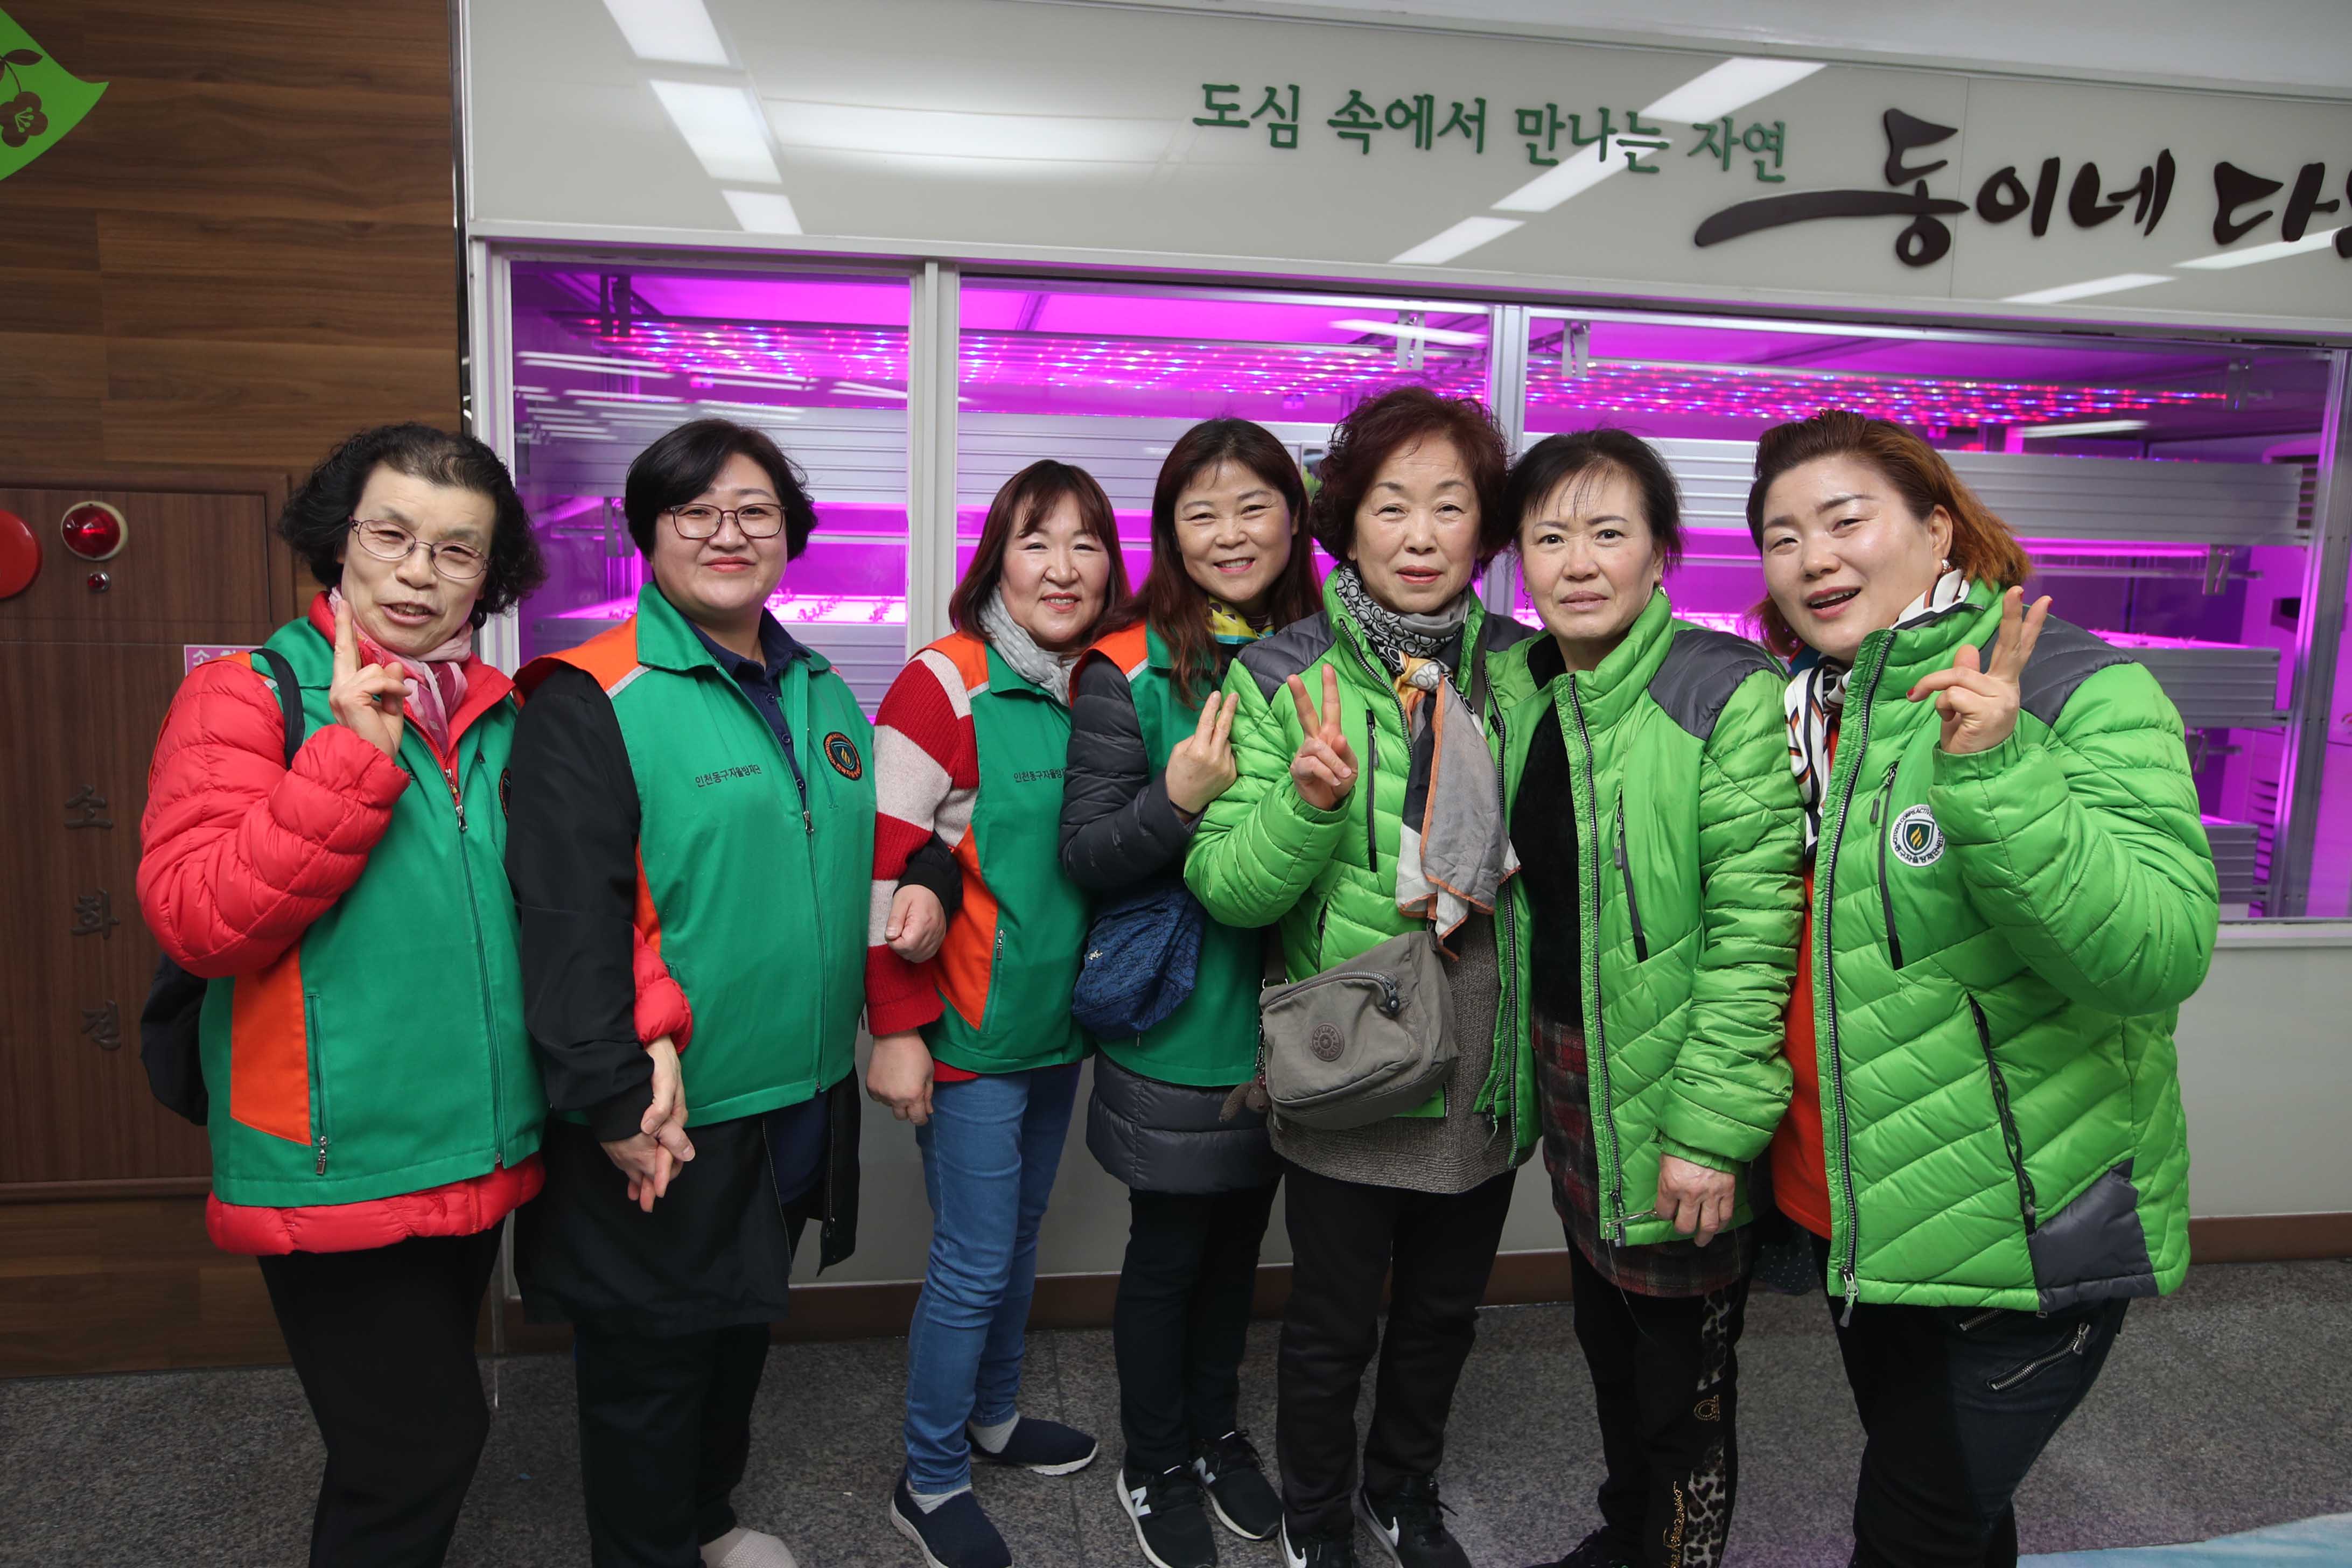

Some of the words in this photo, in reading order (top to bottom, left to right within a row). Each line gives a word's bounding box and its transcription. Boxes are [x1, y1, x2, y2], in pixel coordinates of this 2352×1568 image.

[1193, 84, 1299, 149] 도심
[1327, 89, 1486, 153] 속에서
[1515, 103, 1670, 172] 만나는
[1688, 117, 1786, 182] 자연
[1693, 109, 2175, 268] 동이네
[2213, 162, 2352, 259] 다
[64, 783, 122, 1050] 소화전
